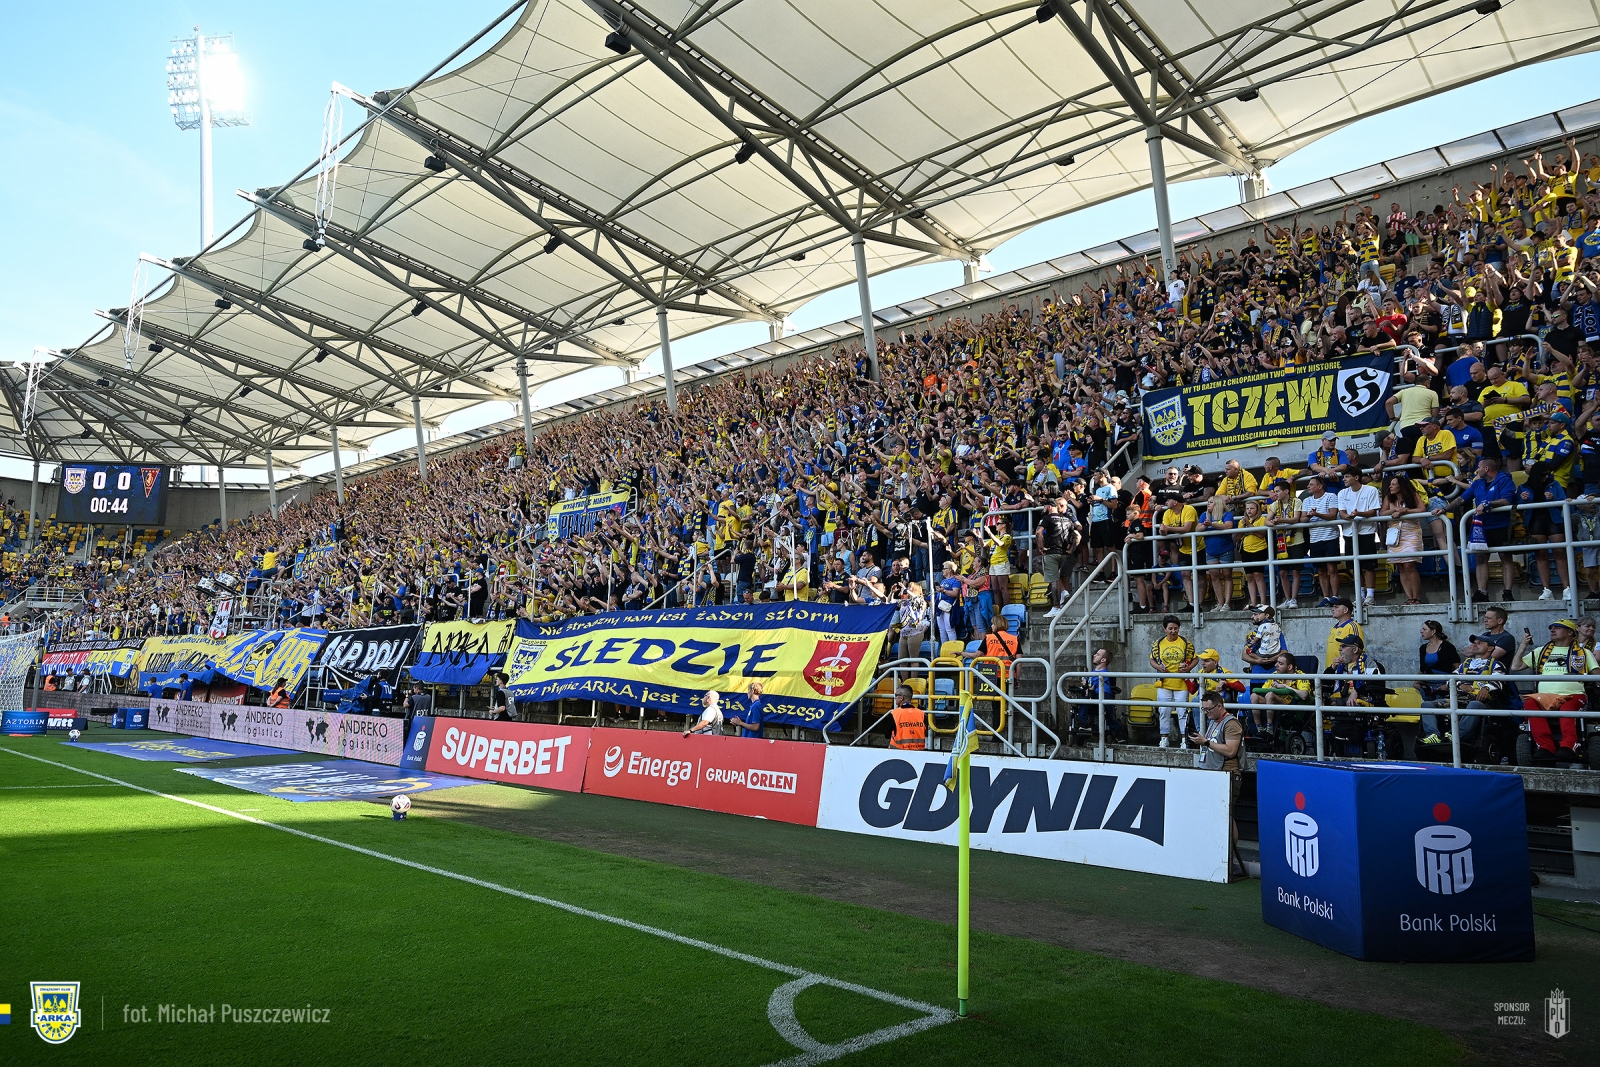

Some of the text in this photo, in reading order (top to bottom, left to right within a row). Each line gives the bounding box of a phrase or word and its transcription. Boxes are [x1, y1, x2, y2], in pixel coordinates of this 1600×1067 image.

[1182, 386, 1192, 395] MY
[1193, 385, 1201, 393] TU
[1201, 380, 1222, 391] RAZEM
[1222, 379, 1227, 387] Z
[1269, 366, 1307, 379] TWOMY
[1187, 374, 1334, 436] TCZEW
[1154, 420, 1182, 434] ARKA
[1222, 430, 1268, 444] WARTOŚCIAMI
[1268, 426, 1304, 437] ODNOSIMY
[92, 471, 132, 490] 0 0
[90, 497, 129, 514] 00:44
[539, 607, 839, 636] Nie straszny nam jest żaden sztorm
[544, 637, 788, 678] ŚLEDZIE
[514, 686, 539, 697] dzie
[541, 680, 579, 696] płynie
[579, 679, 638, 700] ARKA,
[640, 687, 681, 704] jest
[763, 703, 825, 721] aszego
[174, 704, 204, 718] ANDREKO
[245, 710, 283, 726] ANDREKO
[244, 725, 283, 739] logistics
[339, 720, 388, 738] ANDREKO
[899, 721, 924, 729] STEWARD
[338, 736, 388, 753] logistics
[441, 727, 572, 775] SUPERBET
[628, 751, 692, 786] Energa
[706, 767, 746, 785] GRUPA
[749, 770, 794, 791] ORLEN
[858, 758, 1166, 847] GDYNIA
[1277, 886, 1334, 921] Bank Polski
[1400, 914, 1497, 932] Bank Polski
